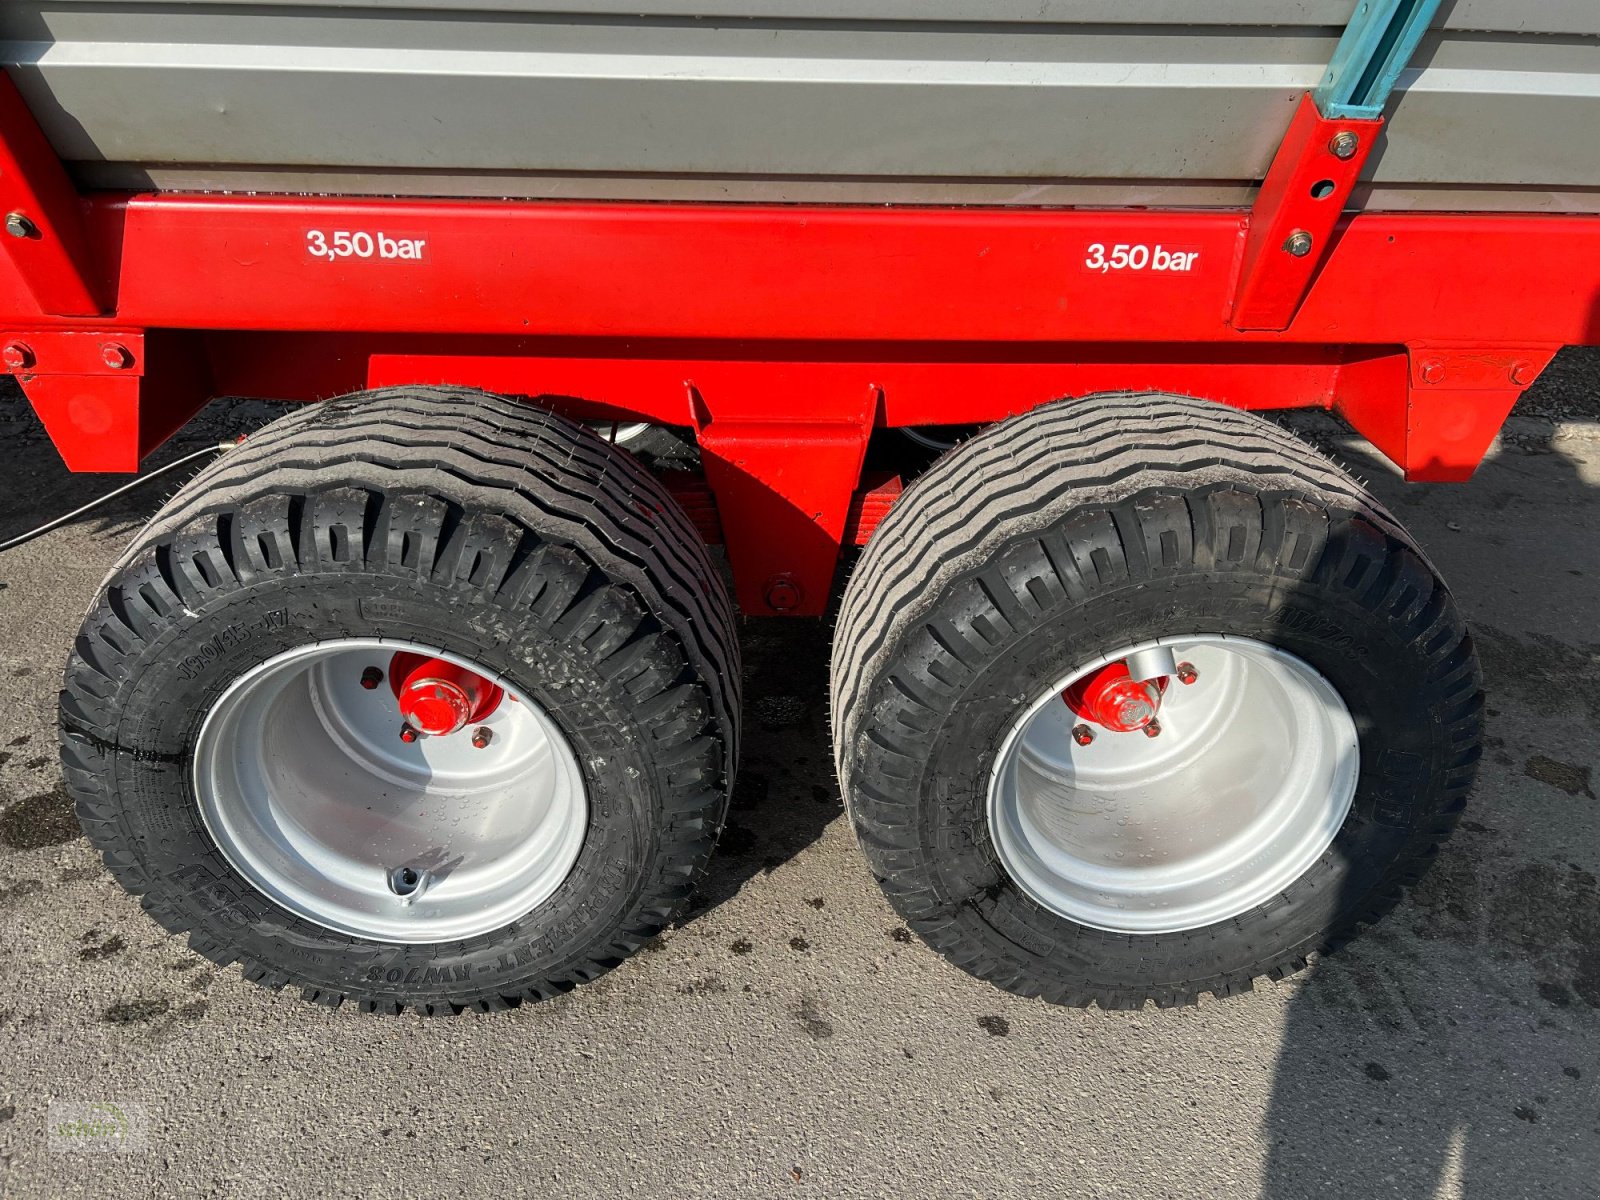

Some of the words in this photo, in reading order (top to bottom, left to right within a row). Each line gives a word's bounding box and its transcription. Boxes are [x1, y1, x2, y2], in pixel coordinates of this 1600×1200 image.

[306, 230, 374, 261] 3,50
[377, 232, 425, 259] bar
[1085, 243, 1149, 273] 3,50
[1151, 245, 1199, 271] bar
